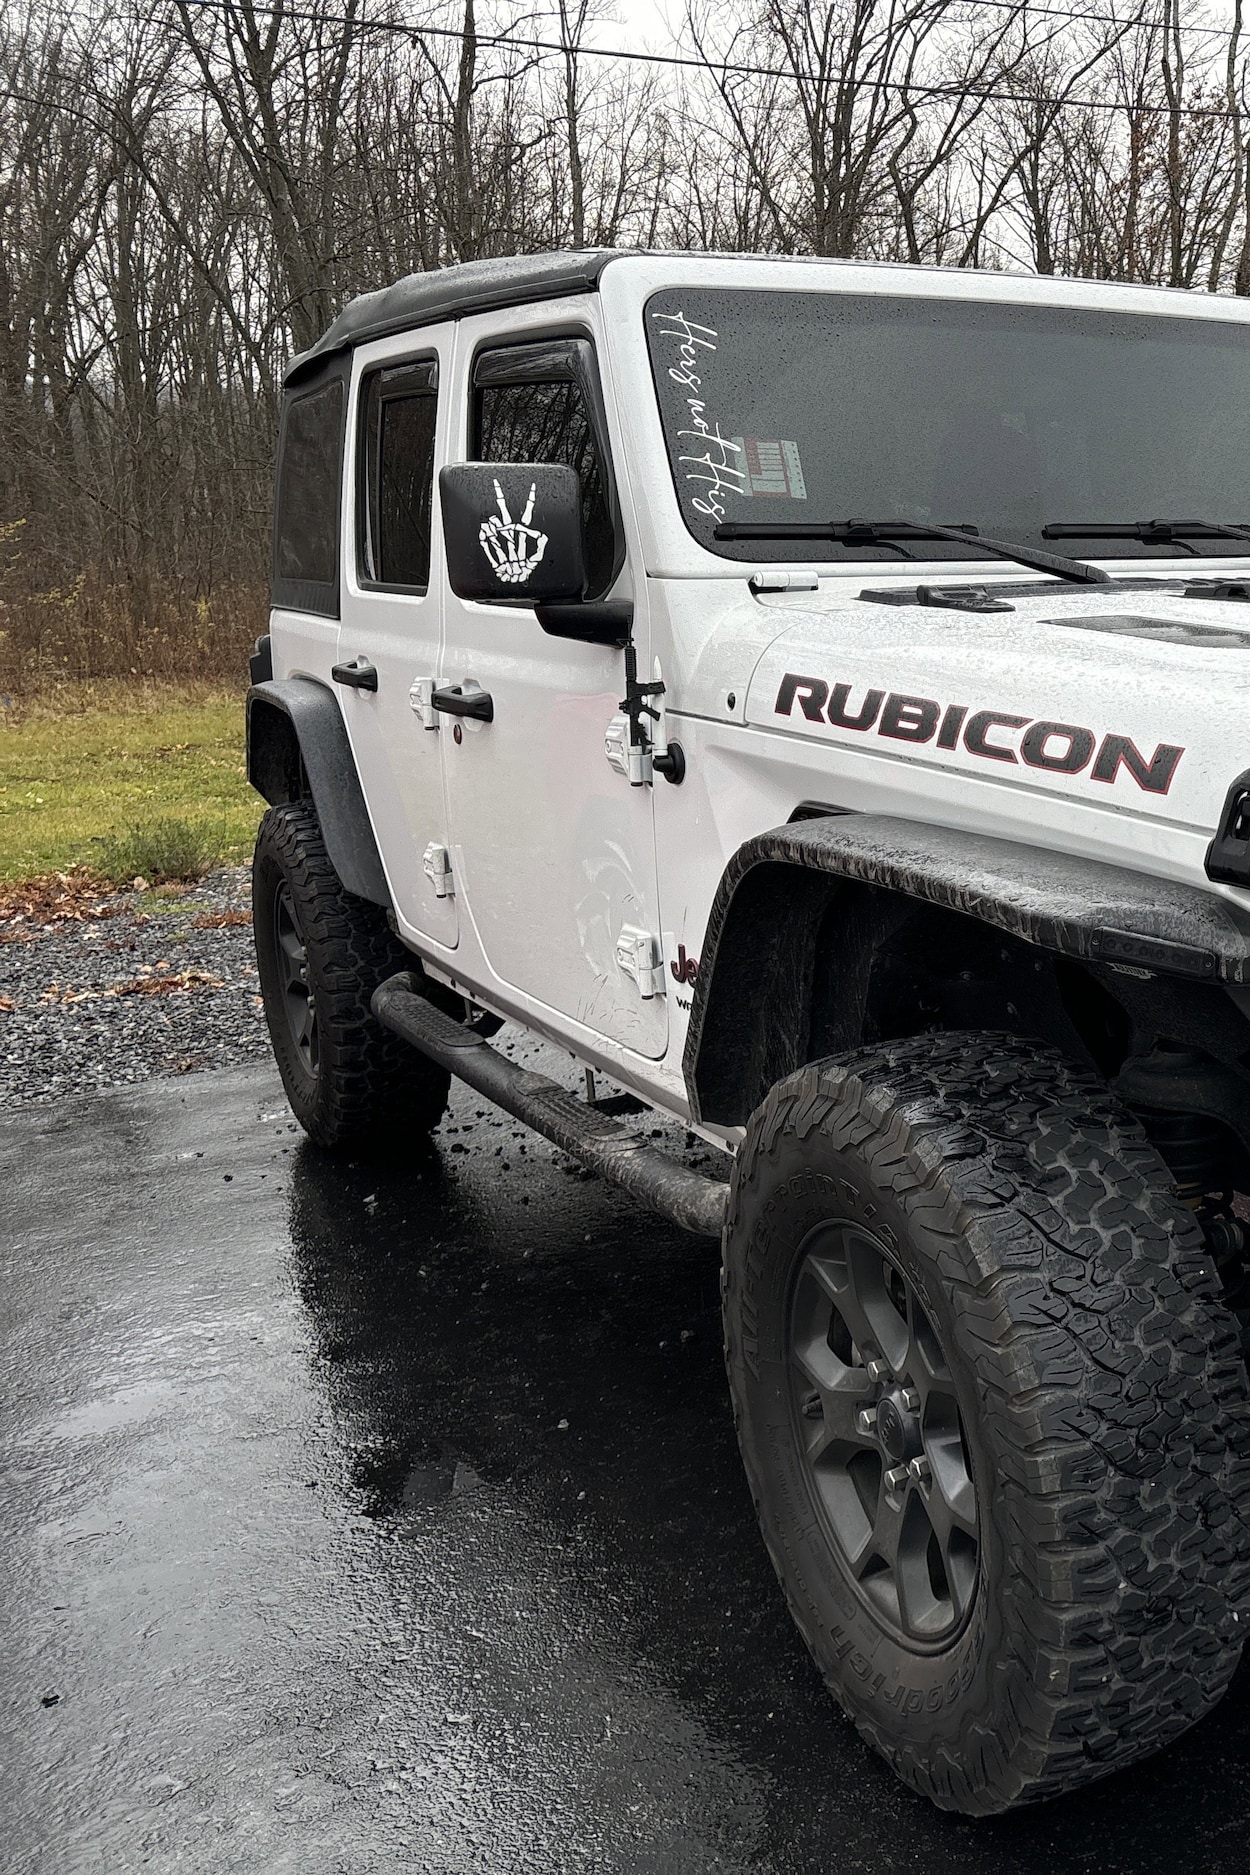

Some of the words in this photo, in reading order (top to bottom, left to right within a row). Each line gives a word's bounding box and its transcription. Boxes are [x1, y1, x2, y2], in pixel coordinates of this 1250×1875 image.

[652, 311, 718, 393] Hers
[678, 453, 746, 524] His
[774, 673, 1186, 796] RUBICON
[670, 943, 700, 989] Je
